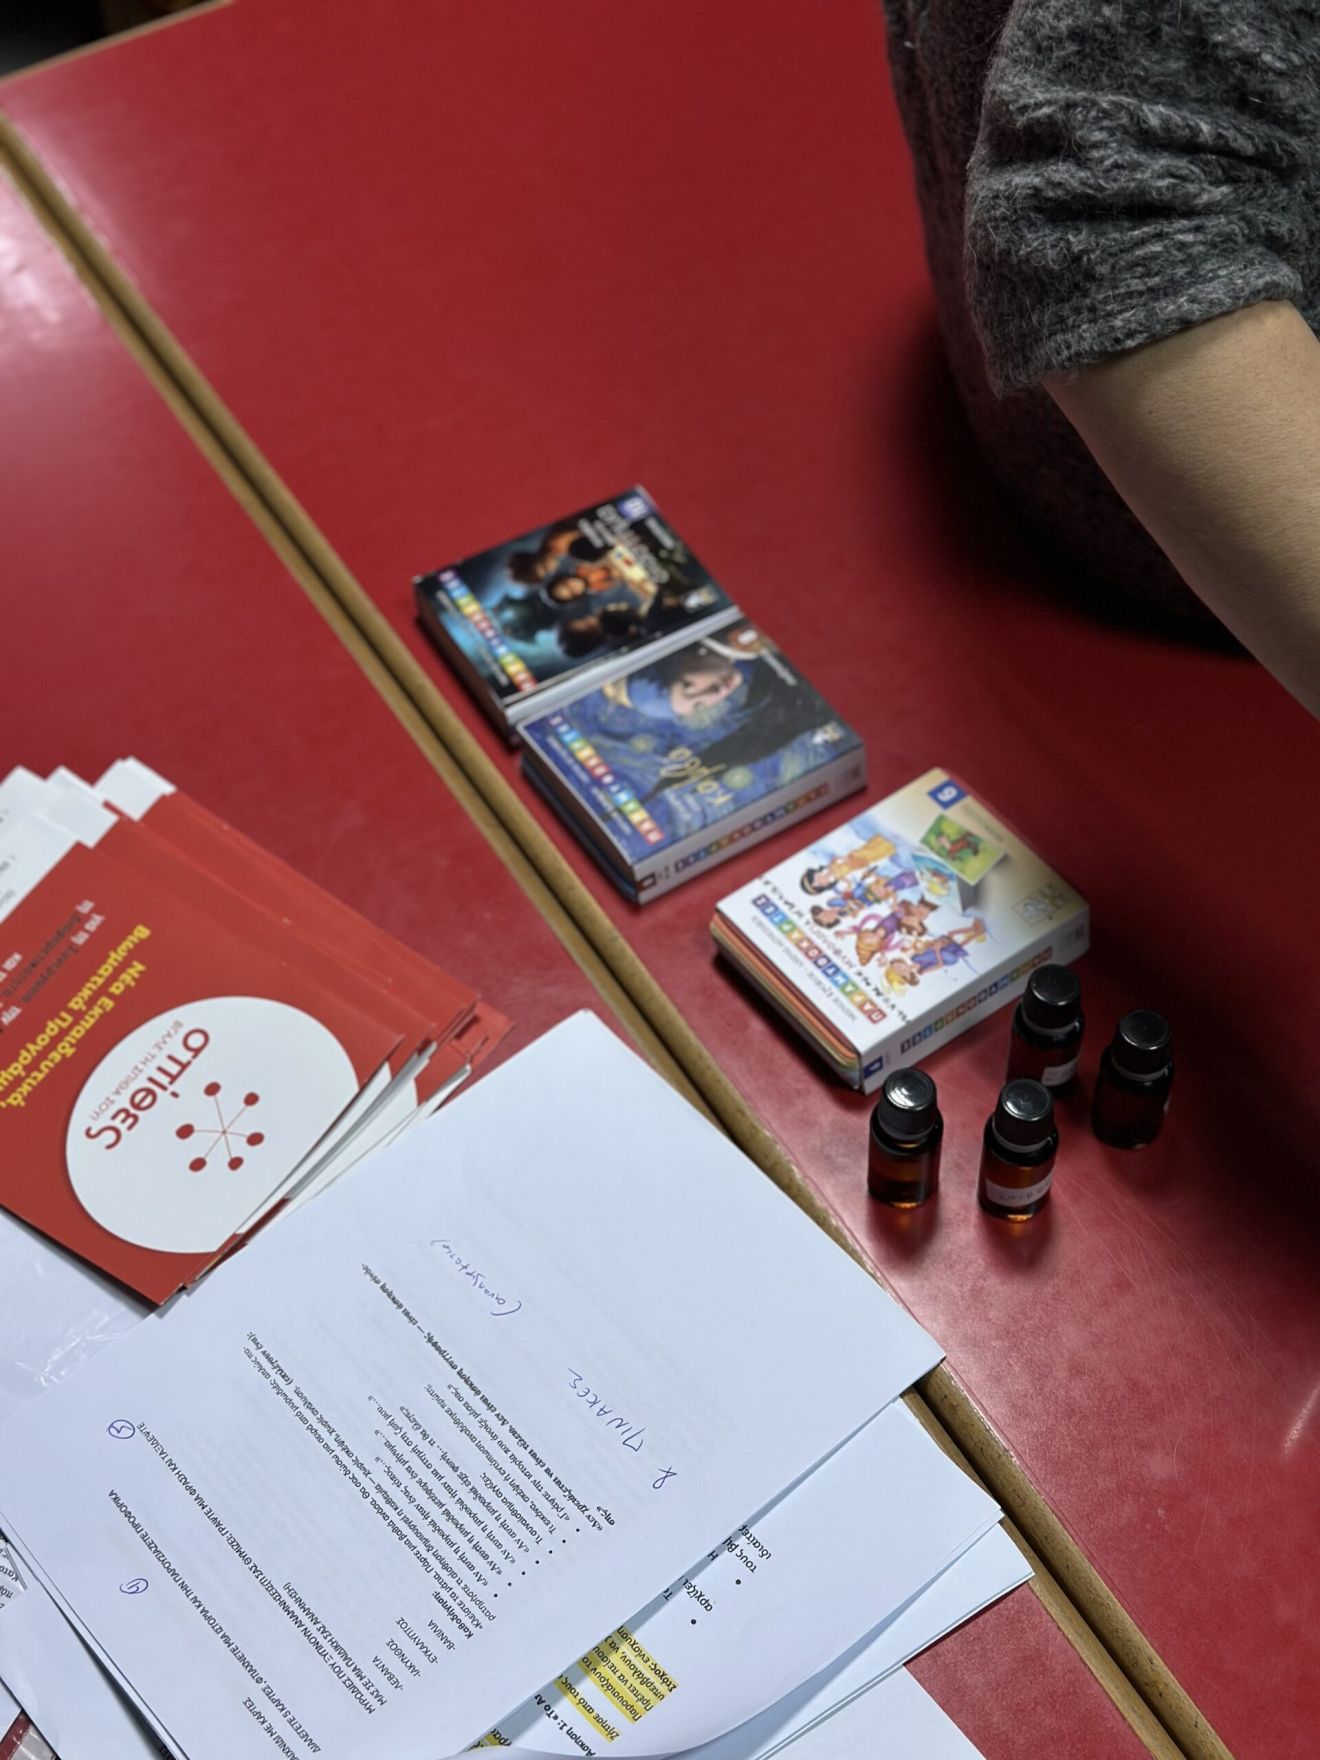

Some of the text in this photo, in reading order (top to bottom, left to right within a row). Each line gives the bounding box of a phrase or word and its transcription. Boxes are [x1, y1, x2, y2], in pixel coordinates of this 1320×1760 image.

[934, 783, 960, 805] 6
[71, 930, 90, 945] τη
[67, 924, 150, 1011] Βιωματικά
[108, 960, 146, 995] Νέα
[152, 1019, 184, 1052] ΒΓΑΛΕ
[139, 1052, 157, 1067] ΤΗ
[84, 1028, 210, 1150] σπίθες
[111, 1064, 143, 1096] ΣΠΙΘΑ
[250, 1356, 271, 1380] απλώς
[293, 1385, 319, 1416] ανάλυση.
[379, 1282, 603, 1531] «Δεν χρειάζεται να είναι τέλειο. Δεν είναι άσκηση συγγραφής είναι άσκηση
[462, 1400, 482, 1419] μέσα
[567, 1367, 646, 1452] ΠΙΝΑΚΕΣ
[294, 1410, 309, 1425] από
[315, 1413, 336, 1436] χωρίς
[477, 1417, 499, 1441] άνοιξε
[136, 1421, 169, 1461] ΤΑΞΙΔΕΨΤΕ
[305, 1423, 325, 1444] σειρά
[419, 1428, 430, 1441] θα
[496, 1440, 511, 1455] που
[322, 1442, 335, 1455] μια
[424, 1383, 551, 1526] εικόνα, σκέψη εντύπωση αναδύθηκε πρώτη;
[164, 1457, 178, 1472] ΚΑΙ
[331, 1453, 351, 1477] δώσω
[351, 1455, 372, 1478] χωρίς
[456, 1471, 471, 1487] είχε
[508, 1452, 533, 1480] ιστορία
[174, 1469, 197, 1496] ΦΡΑΣΗ
[348, 1472, 362, 1488] σας
[359, 1486, 370, 1499] Θα
[386, 1417, 516, 1564] «Αν αυτή μυρωδιά ήταν μια στιγμή στη ζωή
[530, 1479, 544, 1492] την
[108, 1489, 144, 1534] ΠΡΟΦΟΡΙΚΑ
[194, 1493, 208, 1510] ΜΙΑ
[369, 1496, 390, 1522] ανάσα.
[374, 1482, 399, 1512] καθεμία
[467, 1485, 499, 1516] μυρωδιά
[479, 1472, 537, 1537] συναίσθημα αγγίζει;
[541, 1490, 570, 1521] «Γράψτε
[203, 1507, 229, 1537] ΓΡΑΨΤΕ
[386, 1519, 408, 1541] βαθιά
[399, 1514, 434, 1553] δημιουργεί
[404, 1464, 502, 1575] «Αν αυτή μυρωδιά μετέφερε ένα
[498, 1519, 517, 1538] αυτή
[226, 1532, 252, 1565] ΘΥΜΙΖΕΙ;
[400, 1485, 488, 1586] «Αν αυτή μυρωδιά ήταν ένας
[403, 1538, 417, 1552] μια
[514, 1538, 530, 1553] «Αν
[139, 1531, 183, 1583] ΠΑΡΟΥΣΙΑΖΕΤΕ
[247, 1562, 264, 1579] ΣΑΣ
[413, 1549, 434, 1573] Πάρτε
[431, 1548, 458, 1579] αίσθηση
[735, 1548, 757, 1573] τους
[177, 1580, 194, 1599] ΤΗΝ
[433, 1570, 453, 1593] μάτια.
[449, 1590, 459, 1602] τα
[682, 1579, 713, 1612] αρχίζει
[189, 1595, 203, 1609] ΚΑΙ
[431, 1590, 474, 1639] Καθοδήγηση:
[461, 1583, 497, 1621] ρατηρήστε
[199, 1606, 224, 1635] ΙΣΤΟΡΙΑ
[427, 1619, 455, 1650] -ΒΑΝΙΛΙΑ
[219, 1631, 235, 1648] ΜΙΑ
[282, 1581, 387, 1706] ΜΑΣ ΣΕ ΜΙΑ ΠΑΙΔΙΚΗ ΣΑΣ ΑΝΑΜΝΗΣΗ)
[300, 1626, 333, 1664] ΞΥΠΝΟΥΝ
[395, 1616, 438, 1664] -ΕΥΚΑΛΥΠΤΟΣ
[328, 1661, 346, 1680] ΠΟΥ
[385, 1638, 421, 1677] -ΙΑΚΥΝΘΟΣ
[607, 1639, 665, 1701] υπερβάλουν, να
[372, 1655, 403, 1690] -ΛΕΒΑΝΤΑ
[616, 1672, 629, 1686] να
[648, 1662, 677, 1693] Στόχος:
[261, 1684, 287, 1713] ΚΑΡΤΕΣ
[341, 1676, 376, 1714] ΜΥΡΩΔΙΕΣ
[560, 1676, 620, 1741] Ζήτησε από τους
[590, 1667, 642, 1722] Παρουσιάζουν
[627, 1682, 654, 1712] Πρέπει
[281, 1710, 291, 1718] 5
[543, 1704, 559, 1721] «Το
[557, 1719, 568, 1730] 1:
[242, 1696, 300, 1760] ΑΙΧΝΙΔΙ ΜΕ ΚΑΡΤΕΣ
[286, 1715, 321, 1753] ΔΙΑΛΕΓΕΤΕ
